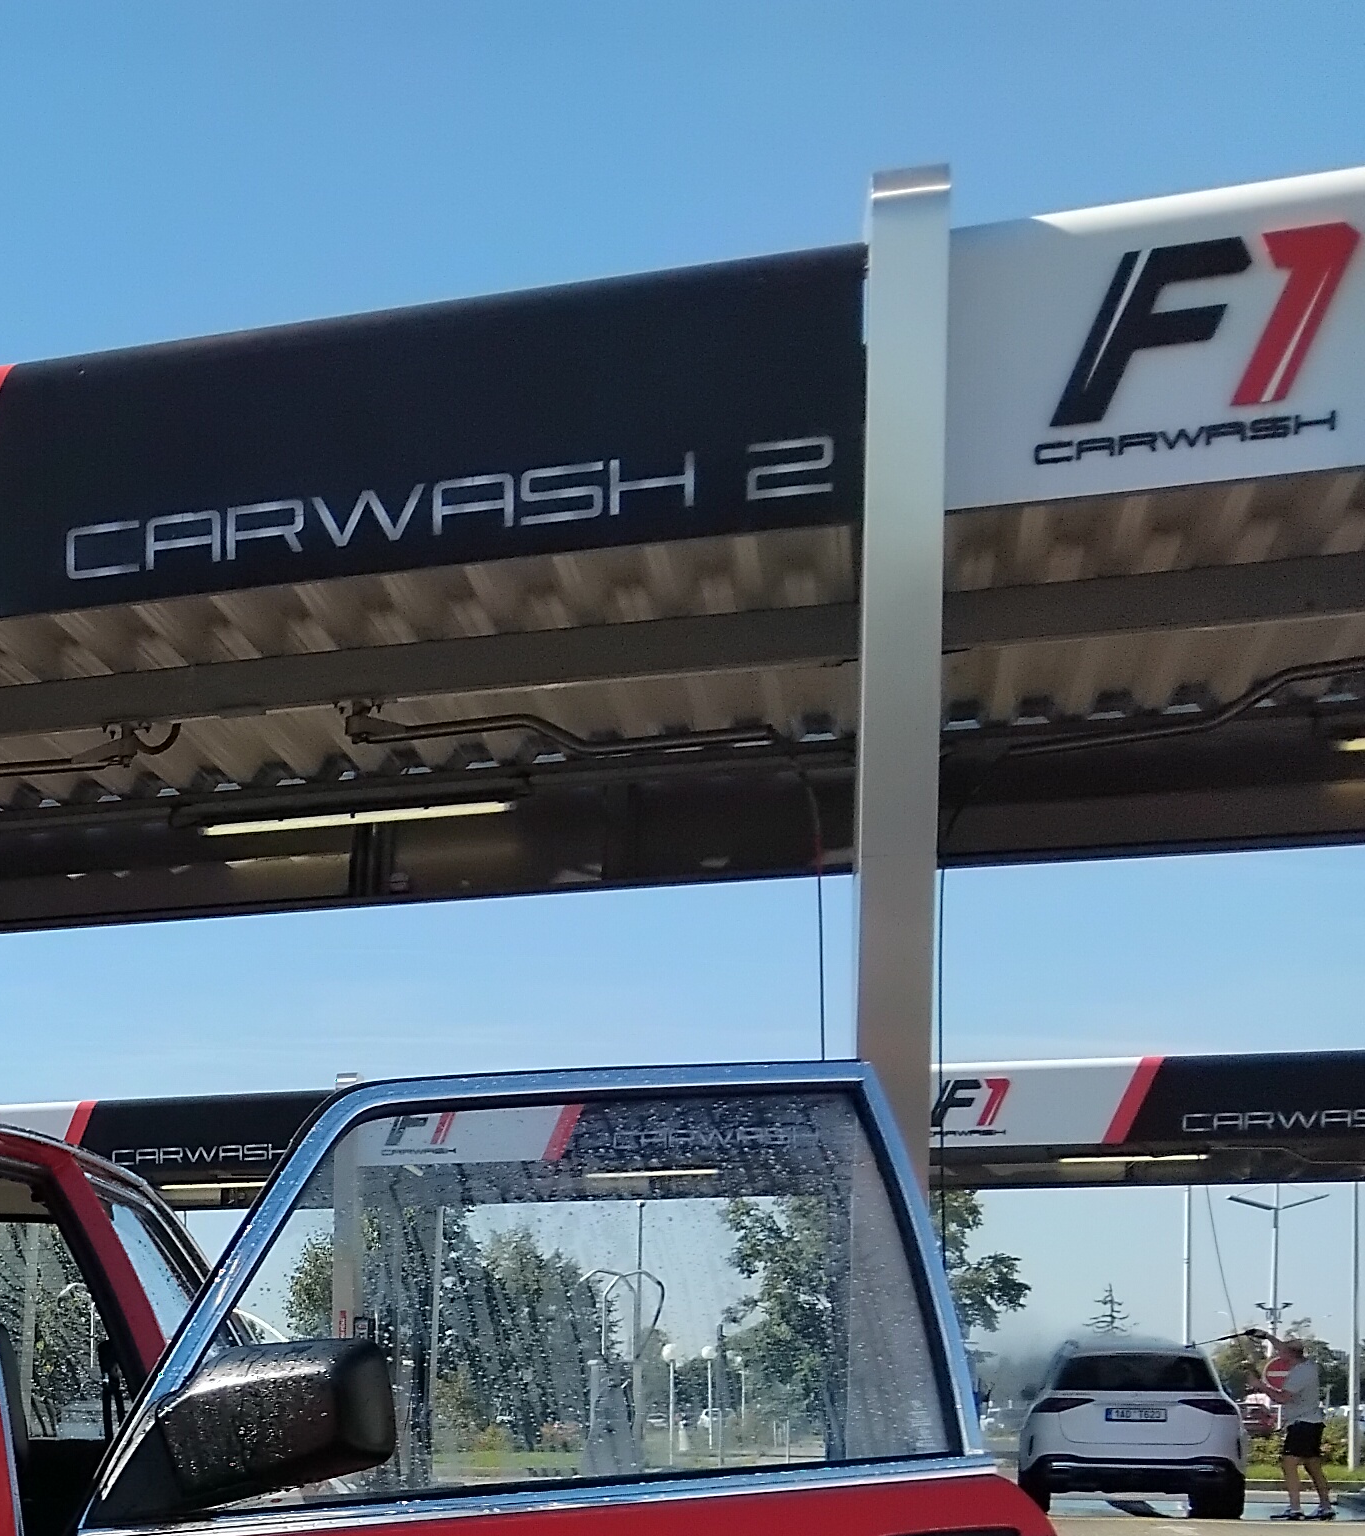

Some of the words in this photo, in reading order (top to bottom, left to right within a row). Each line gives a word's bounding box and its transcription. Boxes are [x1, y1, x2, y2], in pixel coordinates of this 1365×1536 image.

[1050, 222, 1361, 426] F1
[1035, 411, 1336, 465] CARWASH
[66, 452, 695, 580] CARWASH
[747, 436, 834, 500] 2
[931, 1078, 1011, 1128] F1
[112, 1143, 287, 1166] CARWASH
